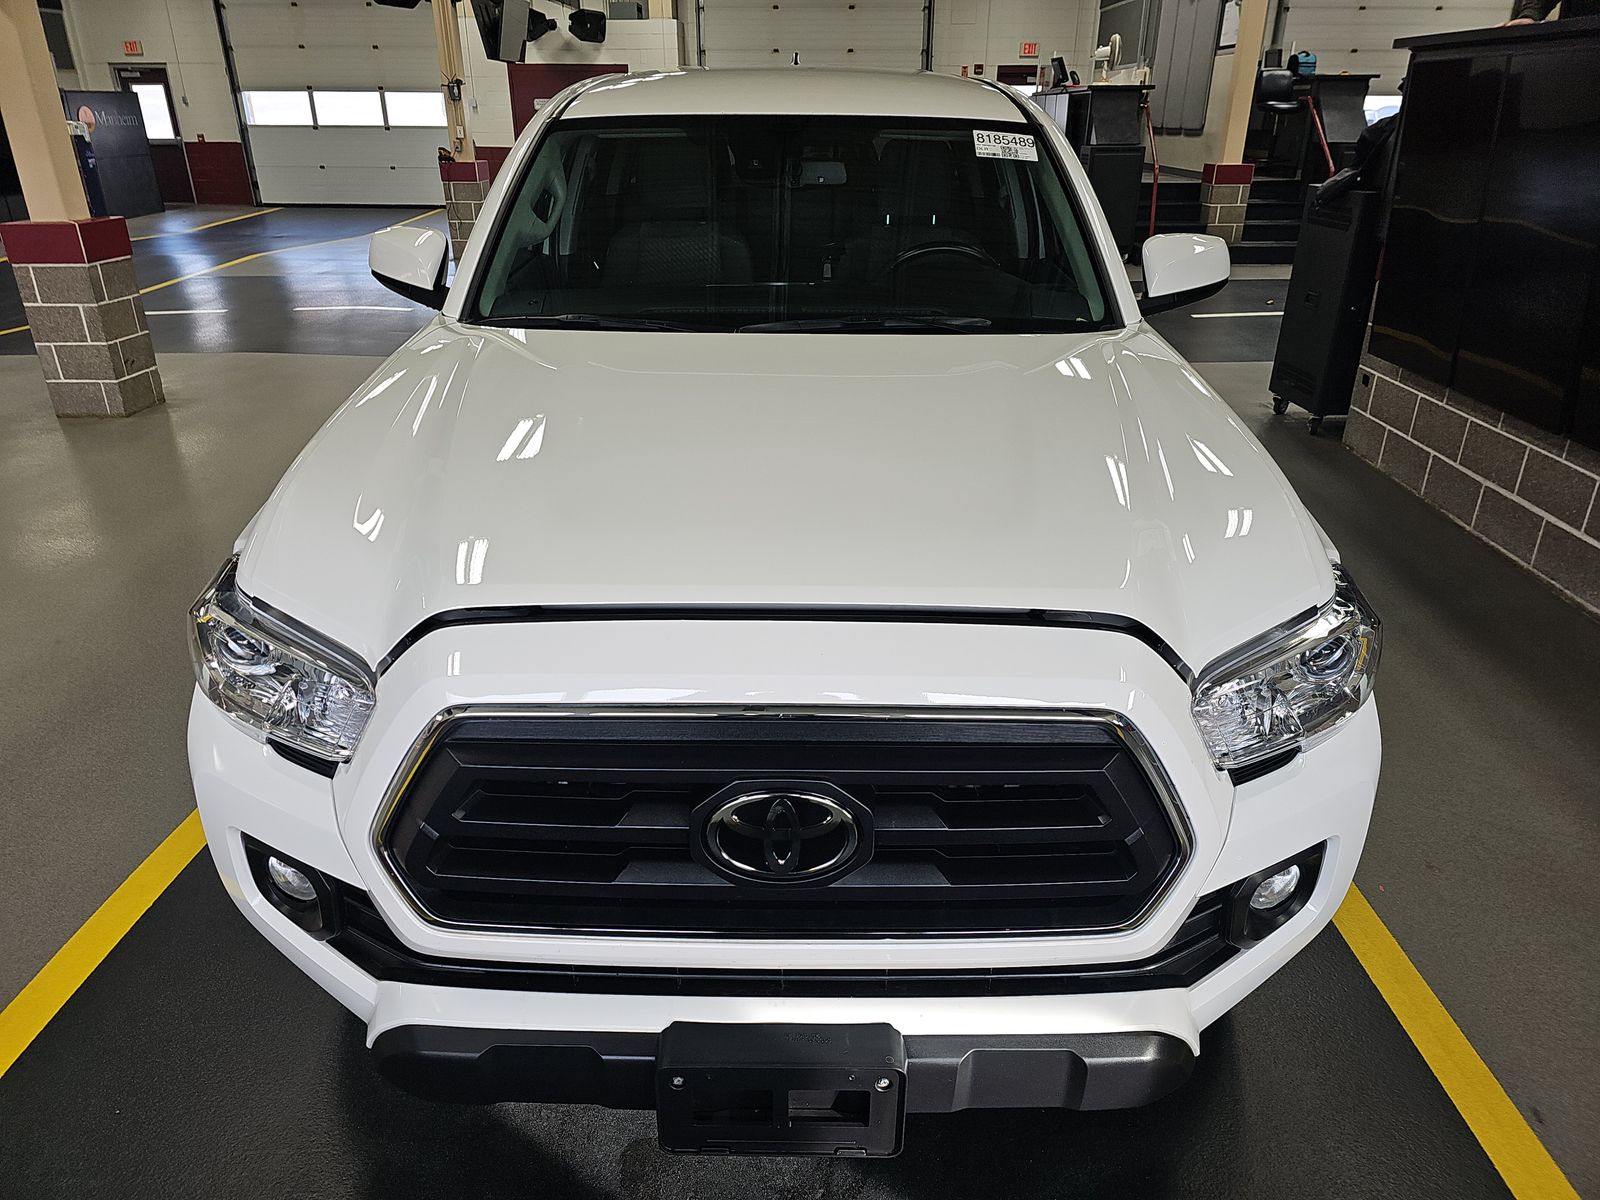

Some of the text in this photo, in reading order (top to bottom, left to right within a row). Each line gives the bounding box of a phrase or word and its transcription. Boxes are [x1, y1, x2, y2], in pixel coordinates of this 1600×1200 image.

[124, 40, 138, 53] EXIT
[1023, 43, 1037, 55] EXIT
[95, 110, 139, 126] Manheim
[976, 132, 1035, 148] 8185489
